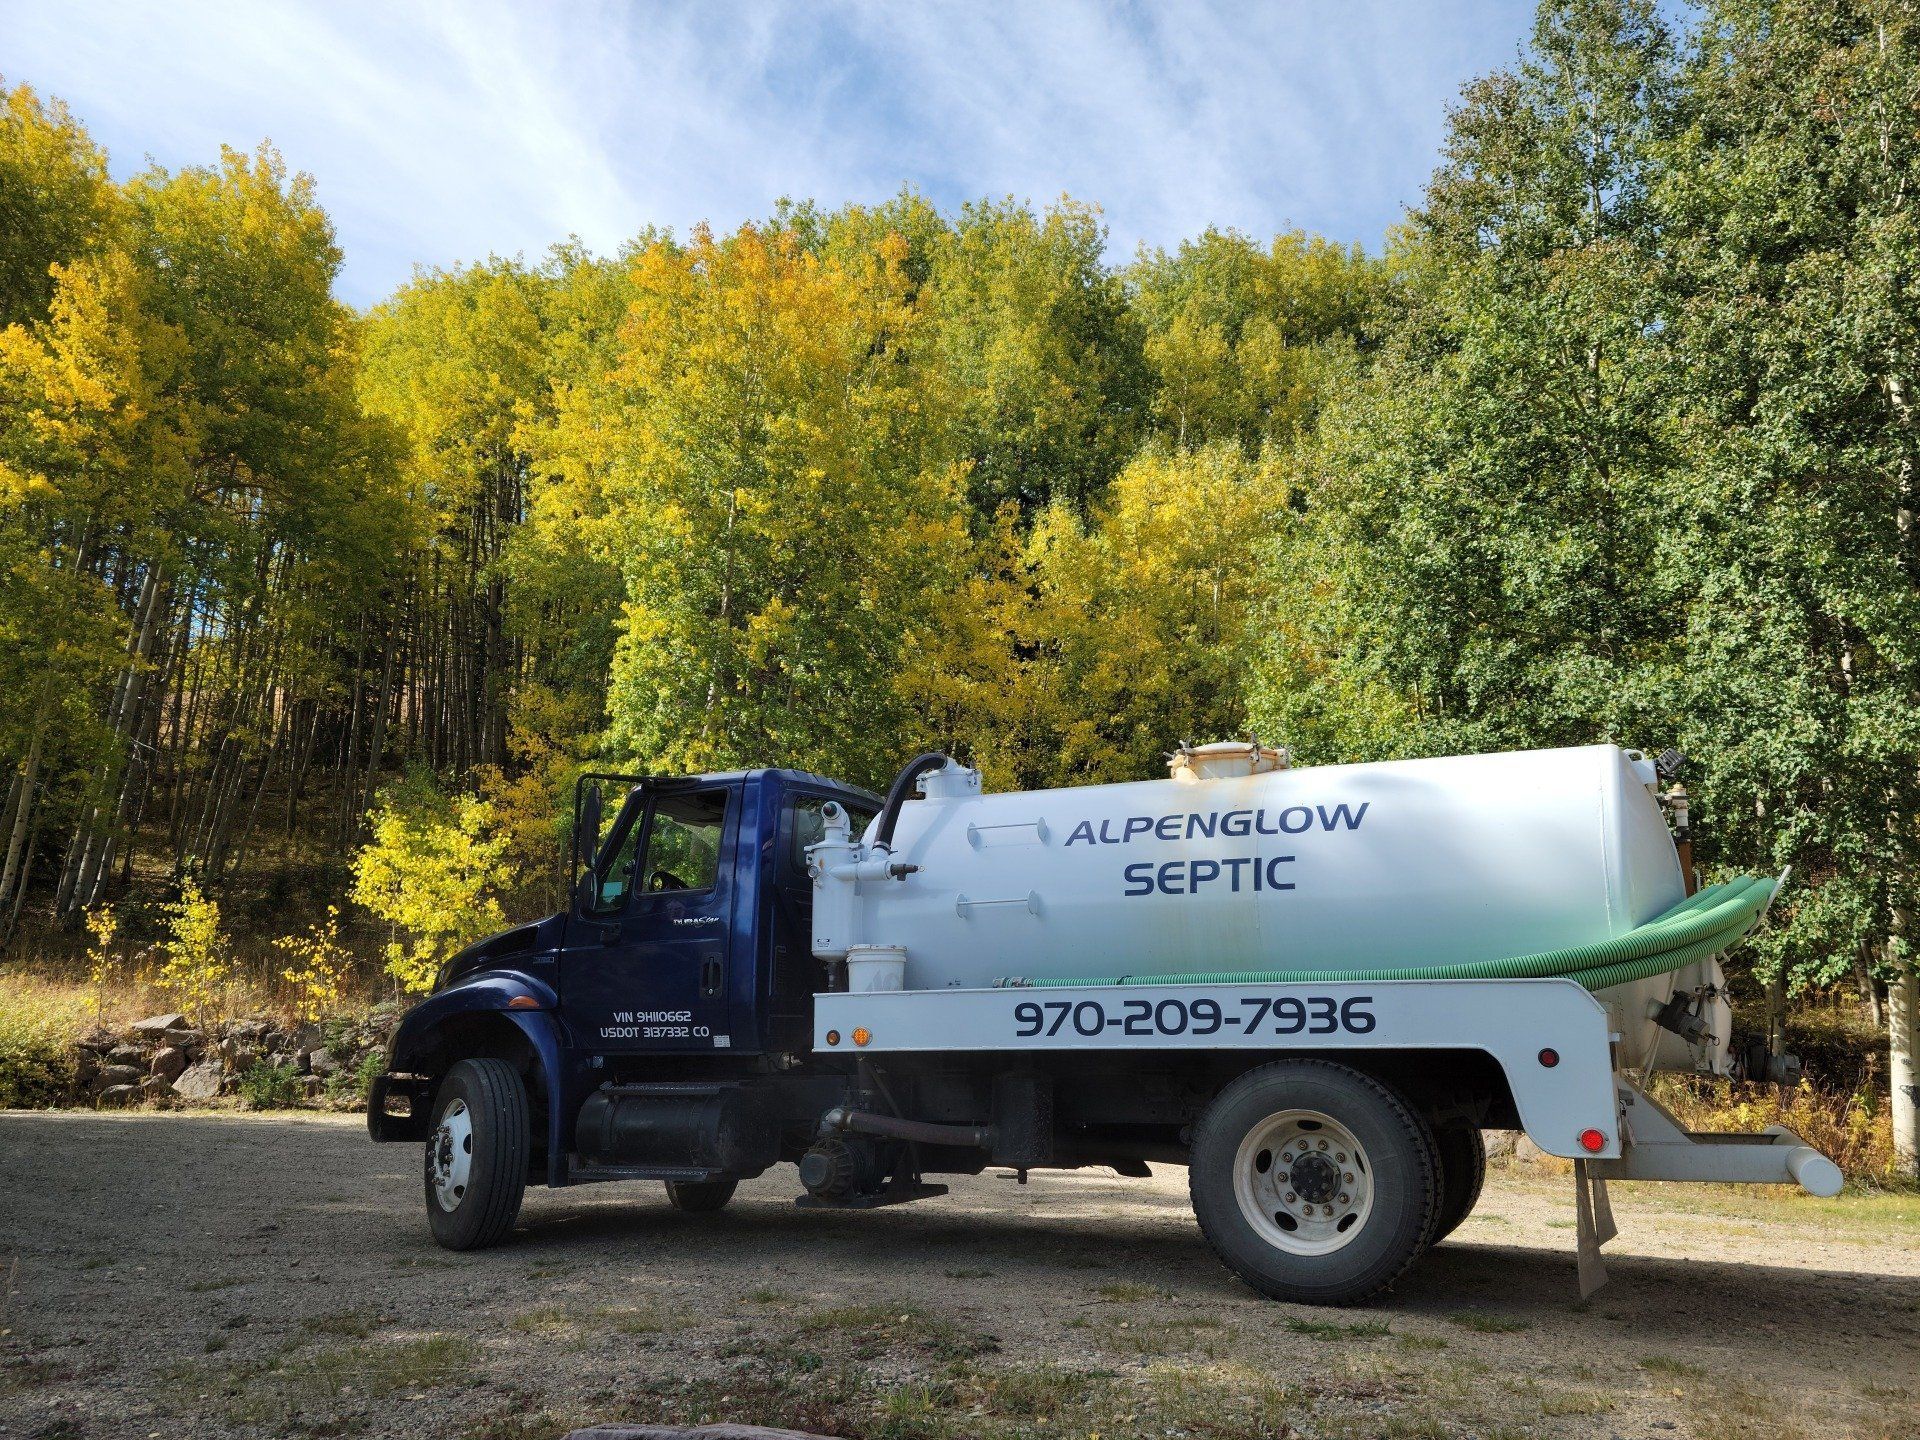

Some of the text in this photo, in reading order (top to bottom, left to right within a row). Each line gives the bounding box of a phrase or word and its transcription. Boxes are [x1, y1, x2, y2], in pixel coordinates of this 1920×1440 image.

[1064, 802, 1370, 847] ALPENGLOW
[1124, 856, 1296, 897] SEPTIC
[600, 1026, 710, 1038] USDOT 3137332 CO
[613, 1011, 634, 1023] VIN
[1014, 996, 1376, 1037] 970-209-7936
